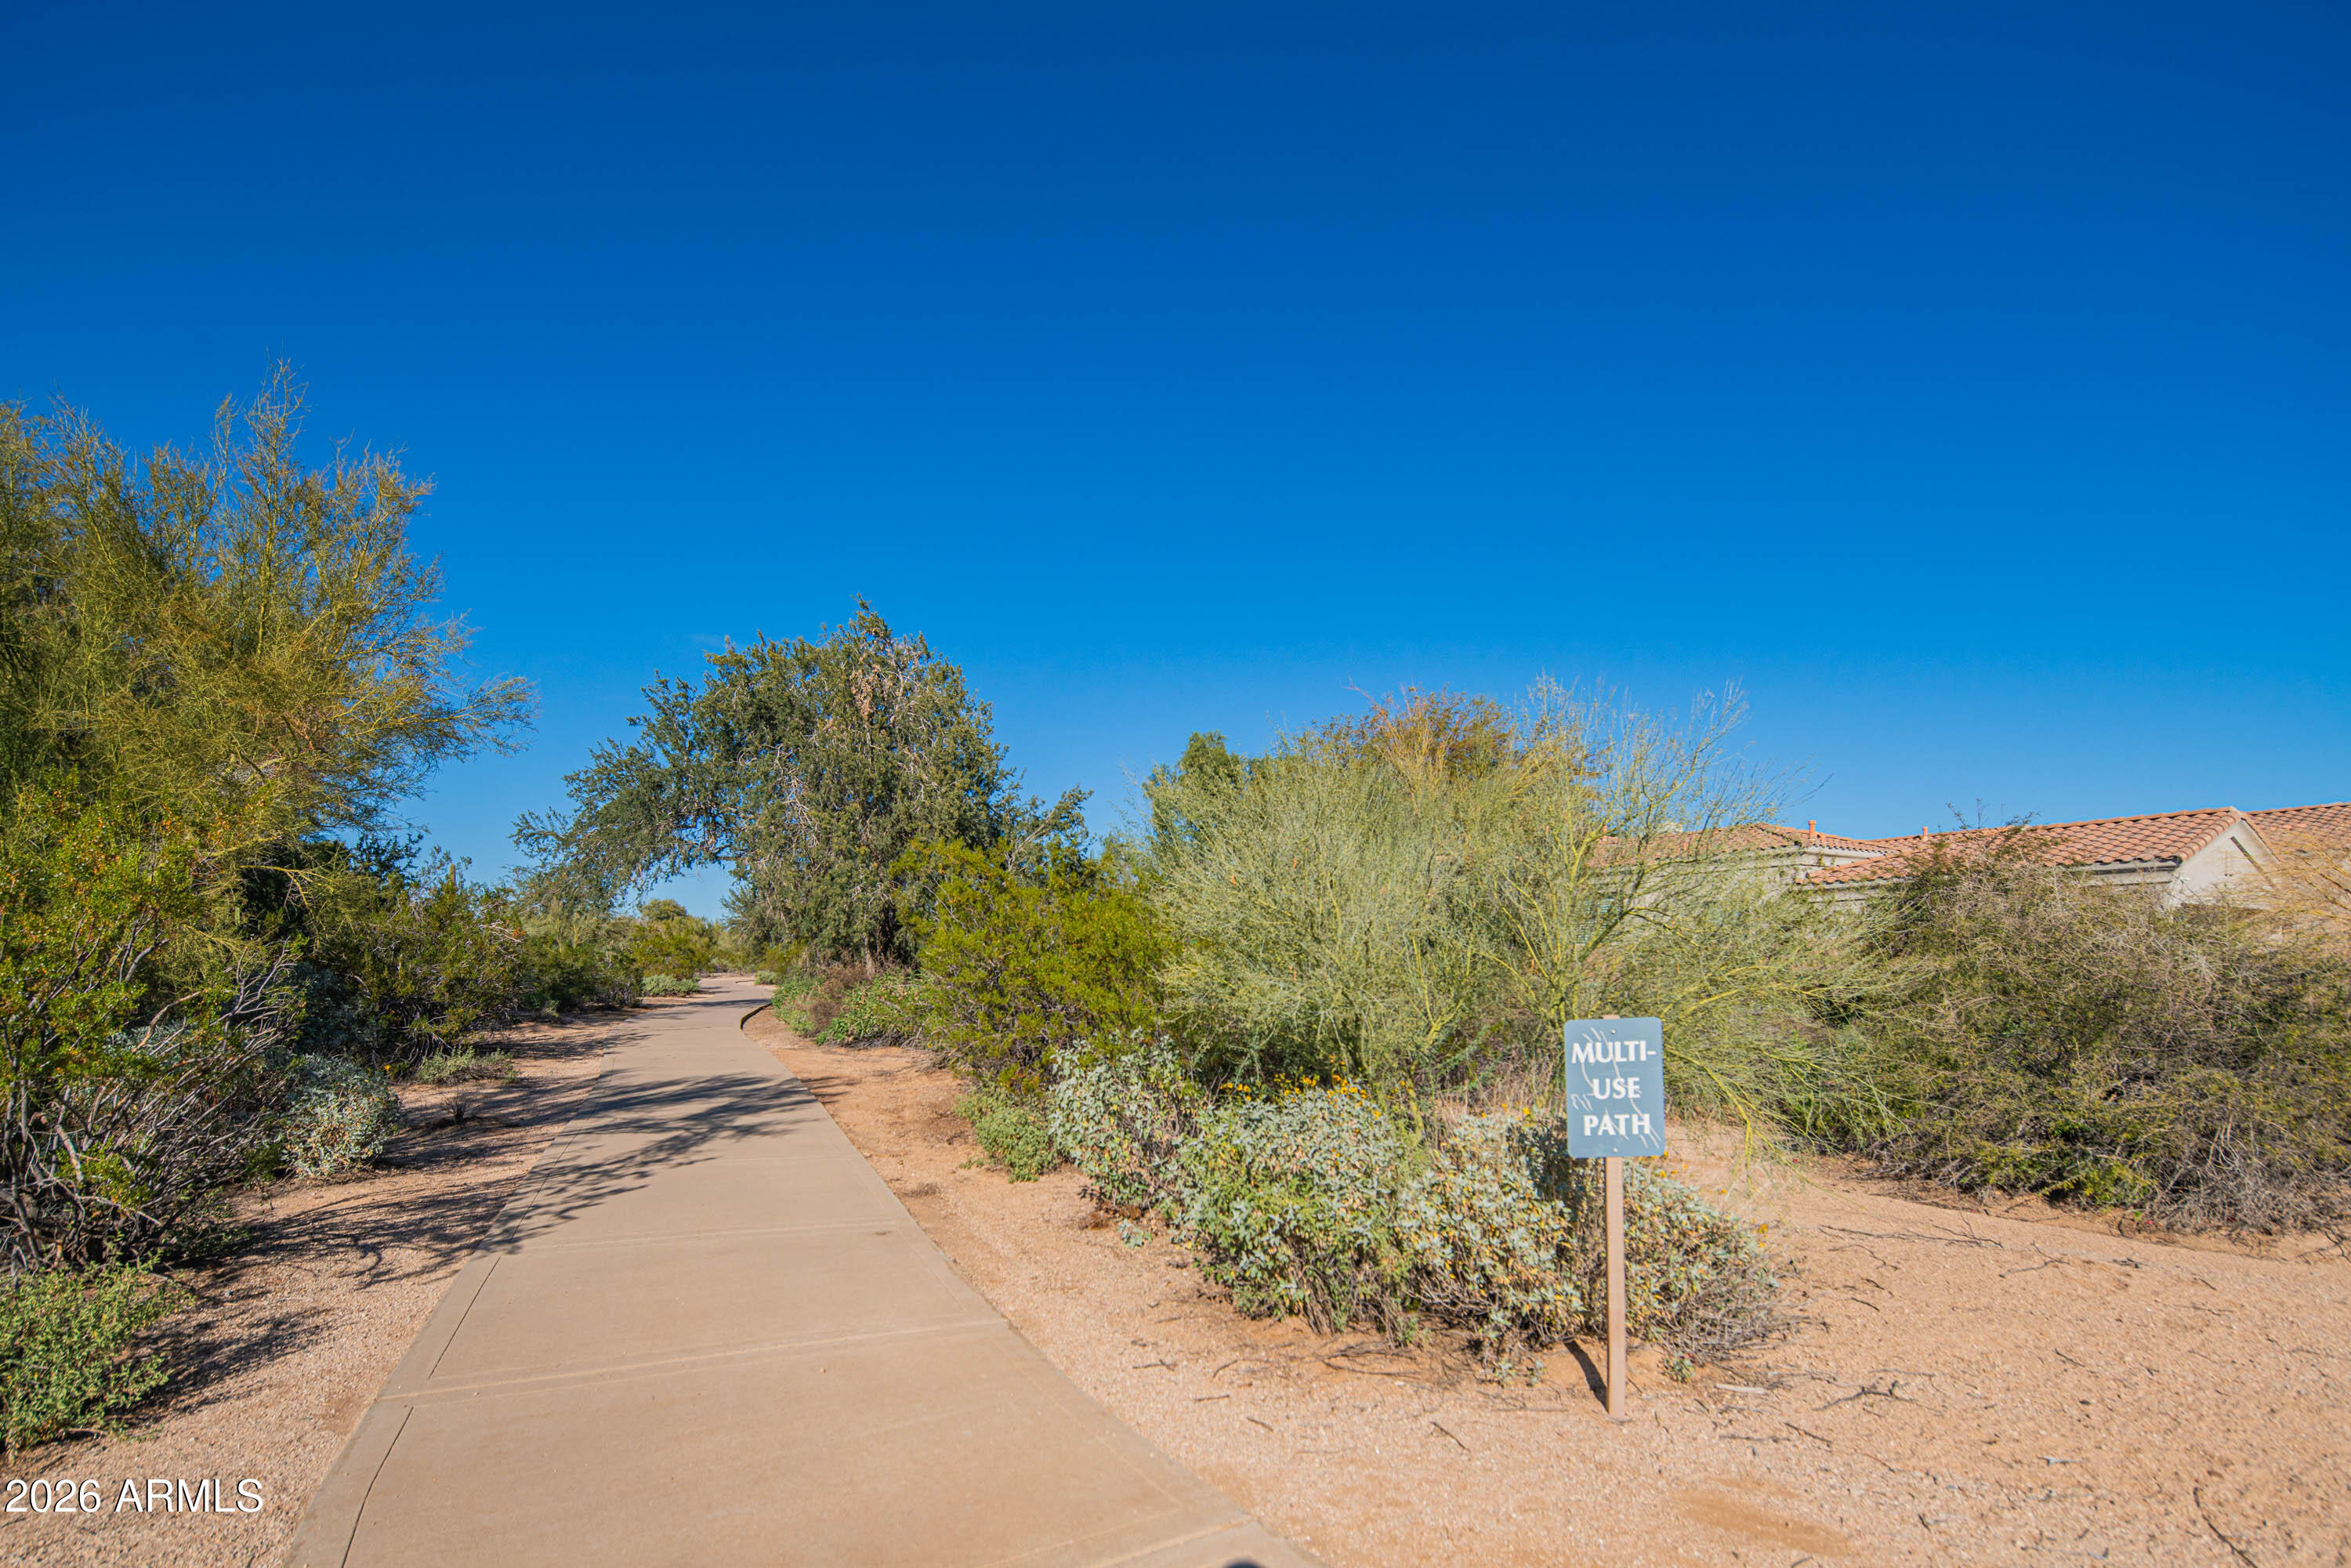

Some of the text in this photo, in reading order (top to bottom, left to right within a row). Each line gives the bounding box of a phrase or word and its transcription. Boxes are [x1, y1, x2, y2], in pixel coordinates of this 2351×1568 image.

[1571, 1041, 1657, 1063] MULTI-
[1592, 1077, 1641, 1099] USE
[1584, 1114, 1650, 1136] PATH
